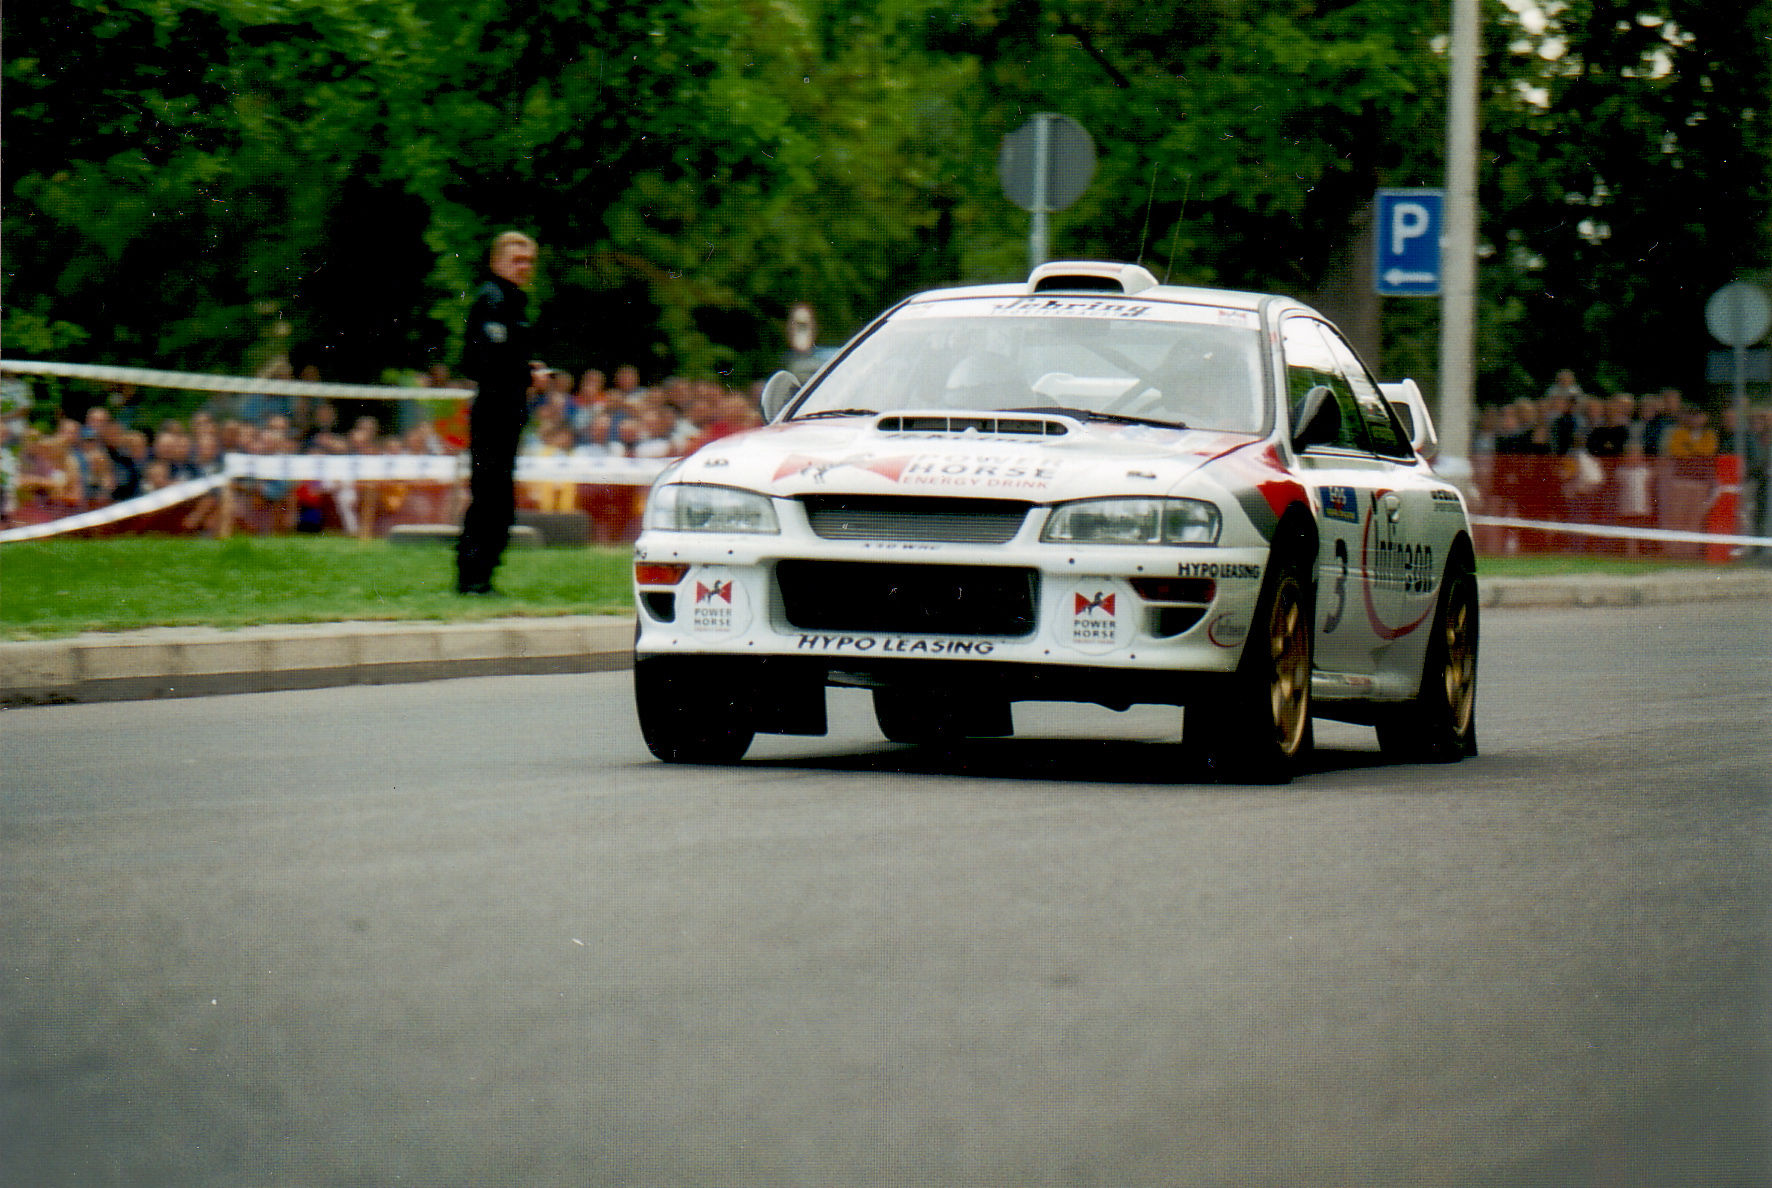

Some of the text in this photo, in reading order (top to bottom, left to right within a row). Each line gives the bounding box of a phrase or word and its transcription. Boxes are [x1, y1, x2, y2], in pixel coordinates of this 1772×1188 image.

[1392, 202, 1429, 255] P
[907, 463, 1055, 480] HORSE
[901, 475, 1049, 490] ENERGY DRINK
[1178, 562, 1261, 580] HYPO LEASING
[1323, 538, 1348, 634] 3
[694, 608, 732, 617] POWER
[694, 618, 732, 627] HORSE
[1073, 619, 1116, 629] POWER
[1073, 629, 1116, 639] HORSE
[798, 634, 995, 655] HYPO LEASING
